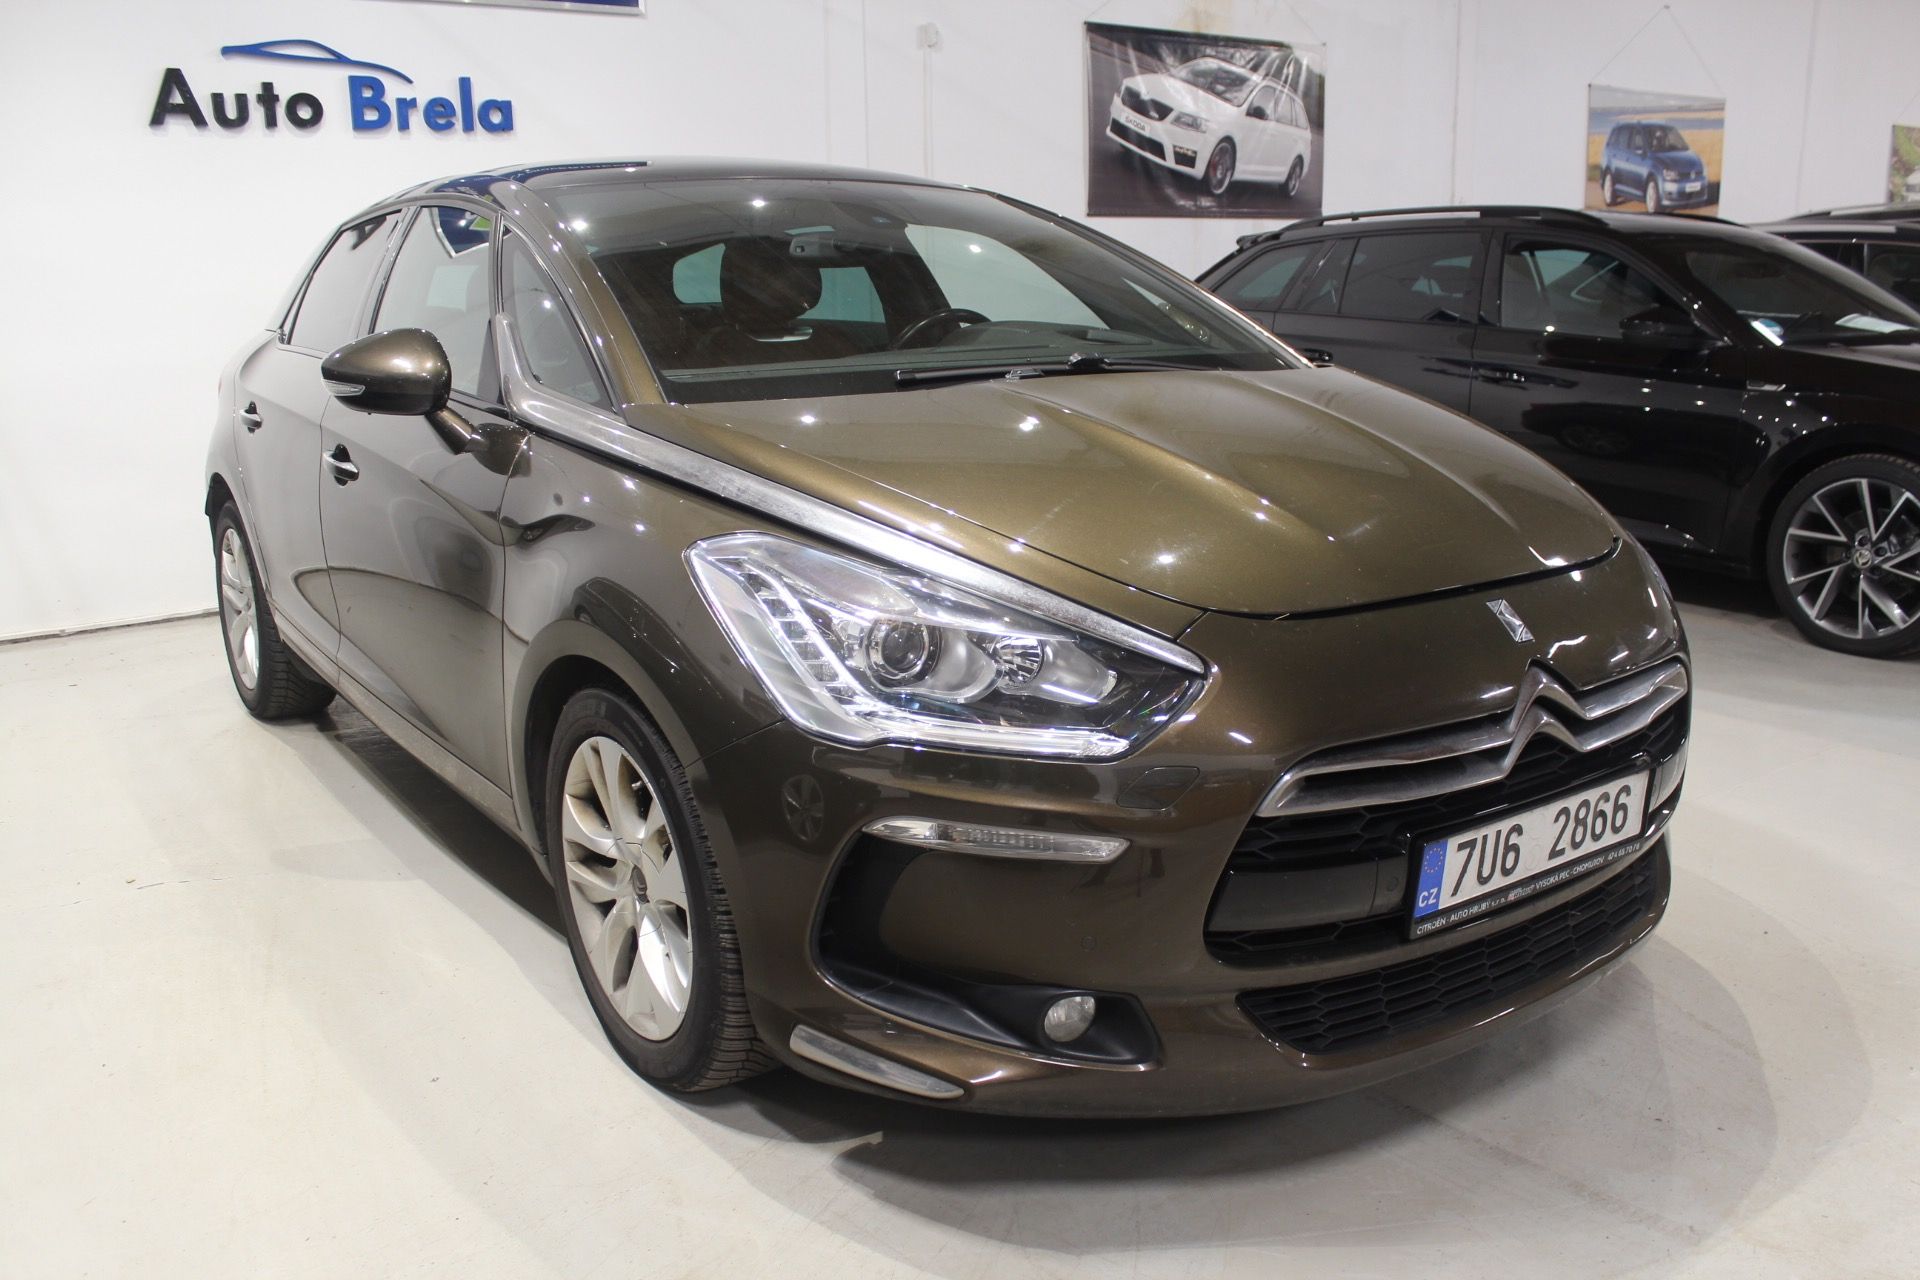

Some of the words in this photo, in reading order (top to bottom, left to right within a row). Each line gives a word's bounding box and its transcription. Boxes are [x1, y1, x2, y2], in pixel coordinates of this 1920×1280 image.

[149, 67, 324, 131] Auto
[346, 74, 515, 134] Brela
[1451, 823, 1524, 898] 7U6
[1547, 784, 1632, 861] 2866
[1418, 887, 1438, 908] CZ
[1449, 909, 1468, 923] AUTO
